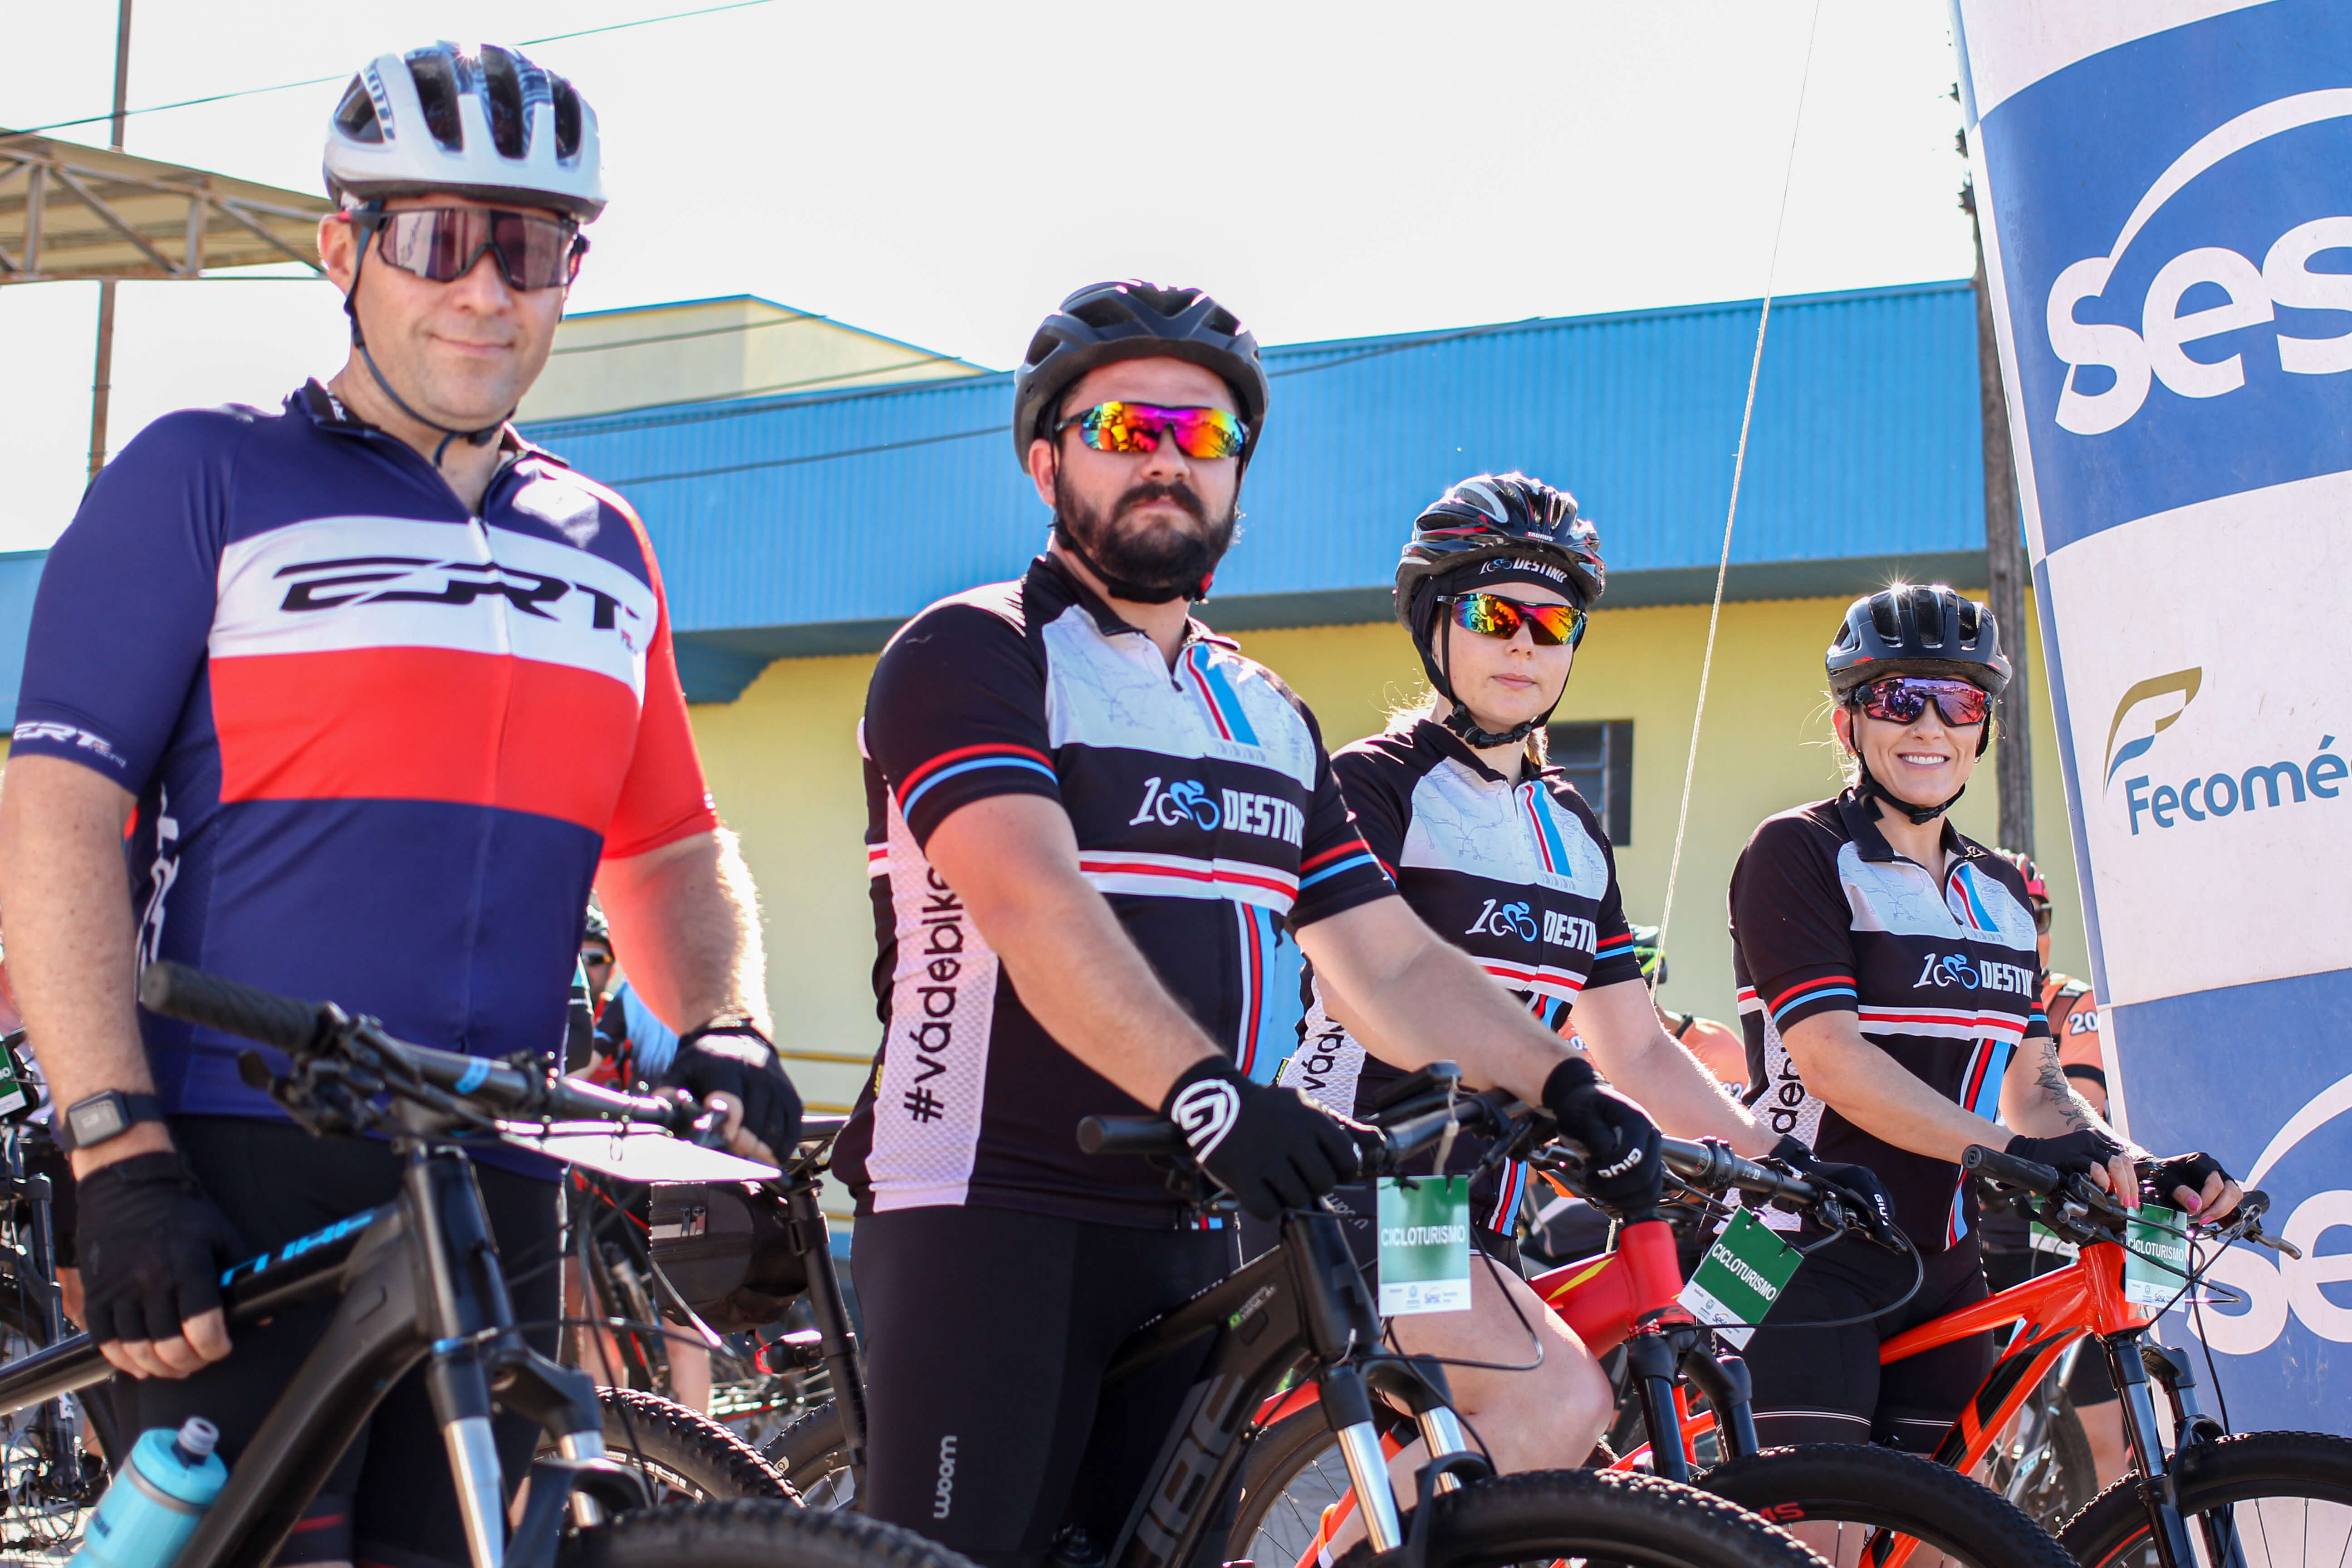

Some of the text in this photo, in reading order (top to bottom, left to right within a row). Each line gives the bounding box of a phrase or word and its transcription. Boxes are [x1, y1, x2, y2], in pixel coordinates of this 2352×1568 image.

[1528, 531, 1553, 542] TAURUS
[2125, 735, 2352, 836] Fecomé
[1381, 1225, 1466, 1247] CICLOTURISMO
[2128, 1237, 2184, 1262] CICLOTURISMO
[1711, 1243, 1778, 1301] CICLOTURISMO
